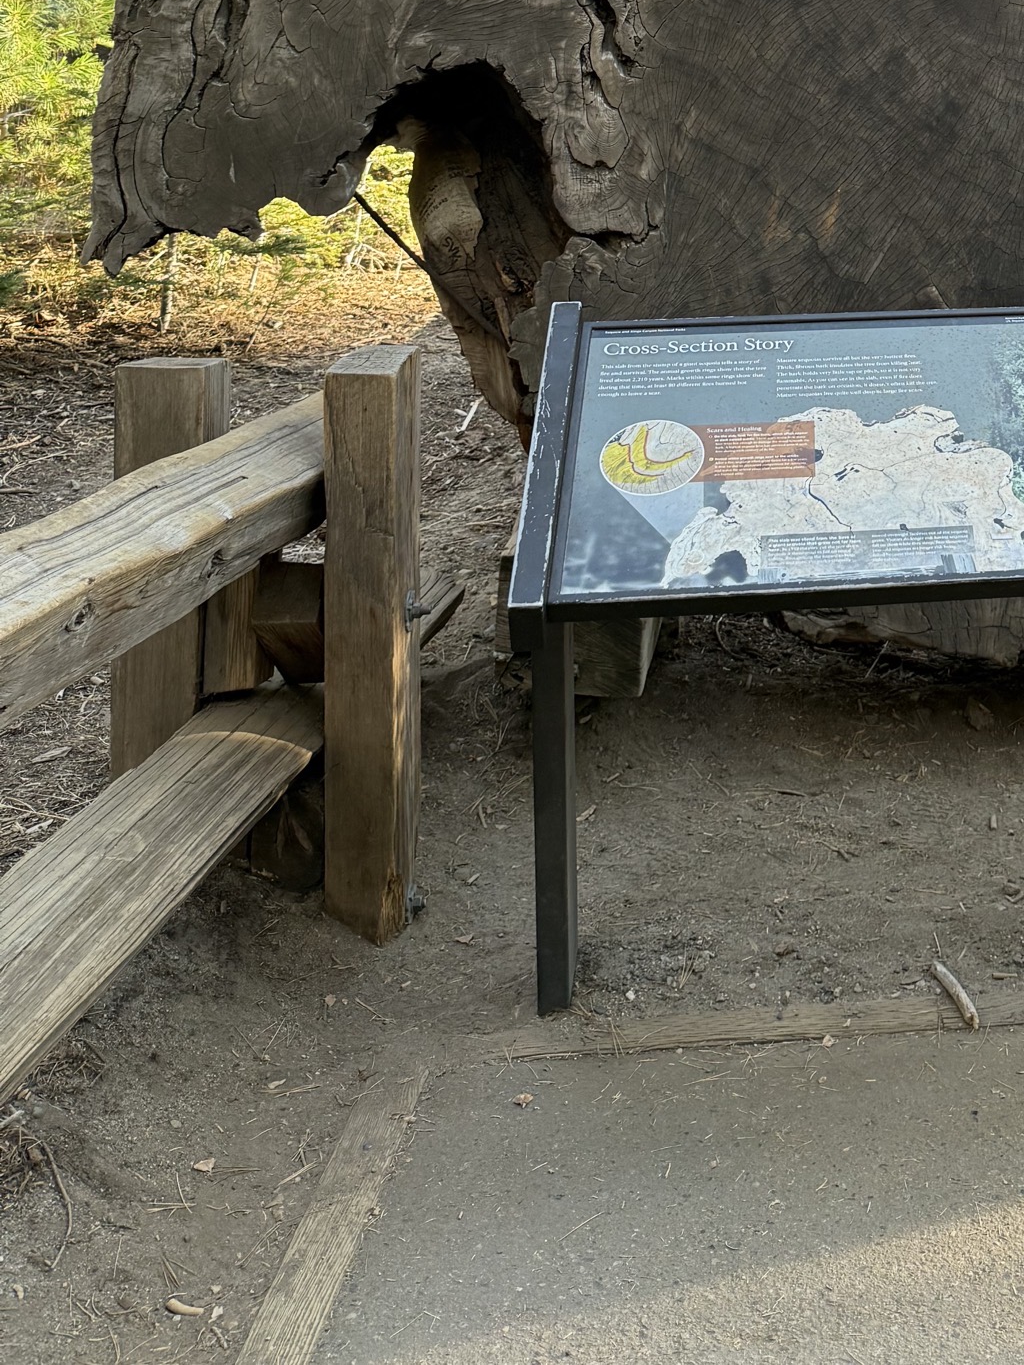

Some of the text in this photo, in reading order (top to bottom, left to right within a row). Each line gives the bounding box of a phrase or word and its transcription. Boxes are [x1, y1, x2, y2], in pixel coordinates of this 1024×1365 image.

[603, 337, 794, 356] Cross-Section Story
[699, 359, 721, 367] sequoia
[680, 367, 701, 375] growth
[721, 373, 735, 381] rings
